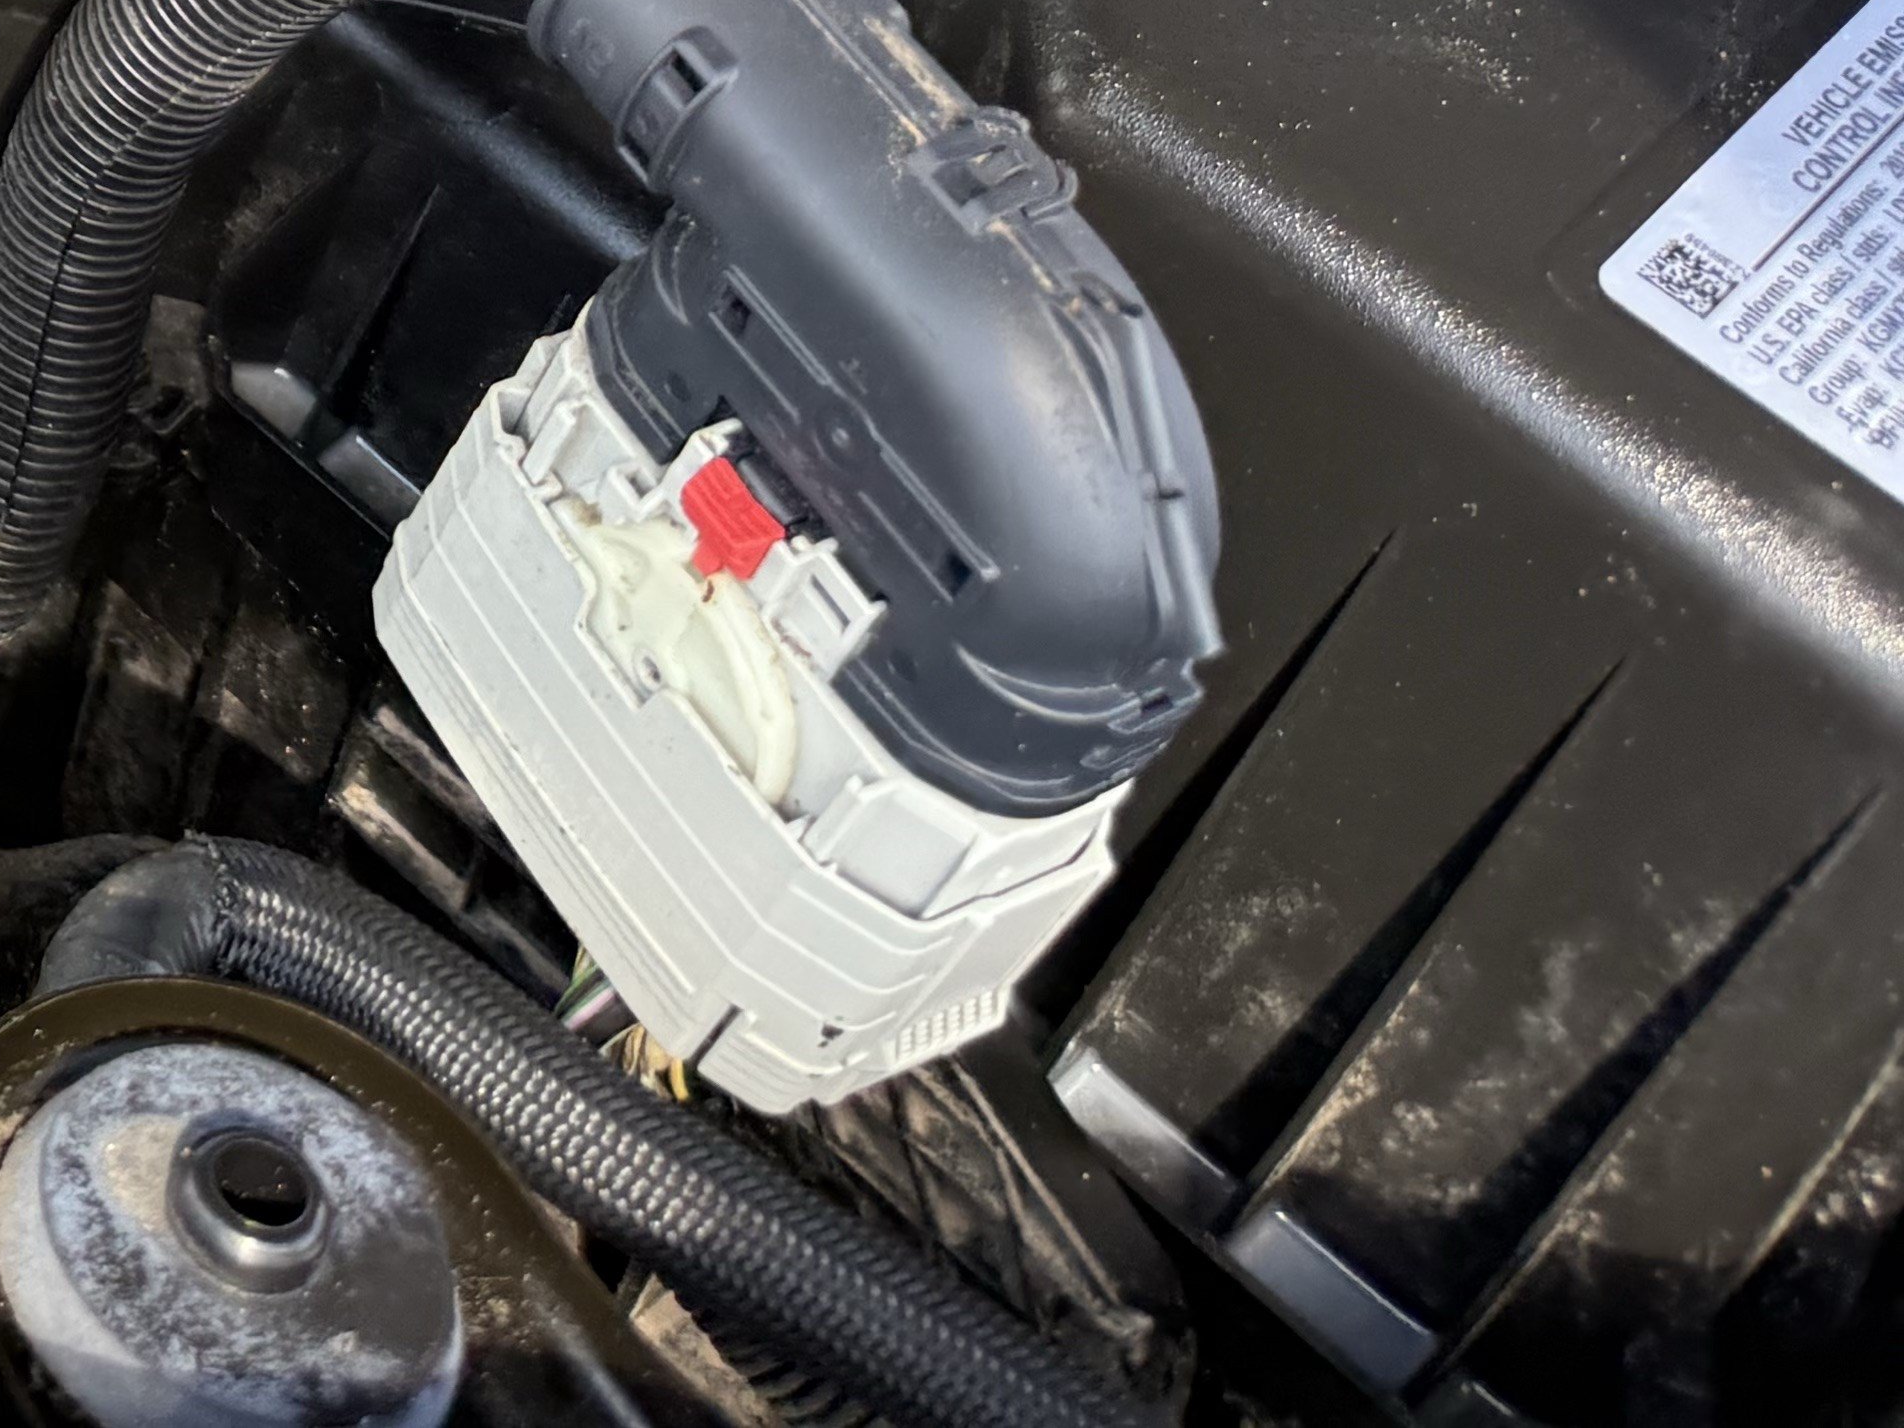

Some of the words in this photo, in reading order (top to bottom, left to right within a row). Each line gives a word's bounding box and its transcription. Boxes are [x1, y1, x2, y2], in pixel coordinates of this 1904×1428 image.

[1782, 66, 1873, 147] VEHICLE
[1793, 106, 1891, 193] CONTROL
[1719, 274, 1796, 344] Conforms
[1784, 261, 1810, 281] to
[1797, 179, 1889, 262] Regulations:
[1747, 332, 1790, 366] U.S.
[1777, 301, 1819, 337] EPA
[1811, 265, 1856, 307] class
[1852, 224, 1895, 263] stds:
[1779, 314, 1852, 386] California
[1845, 280, 1889, 320] class
[1808, 354, 1868, 406] Group:
